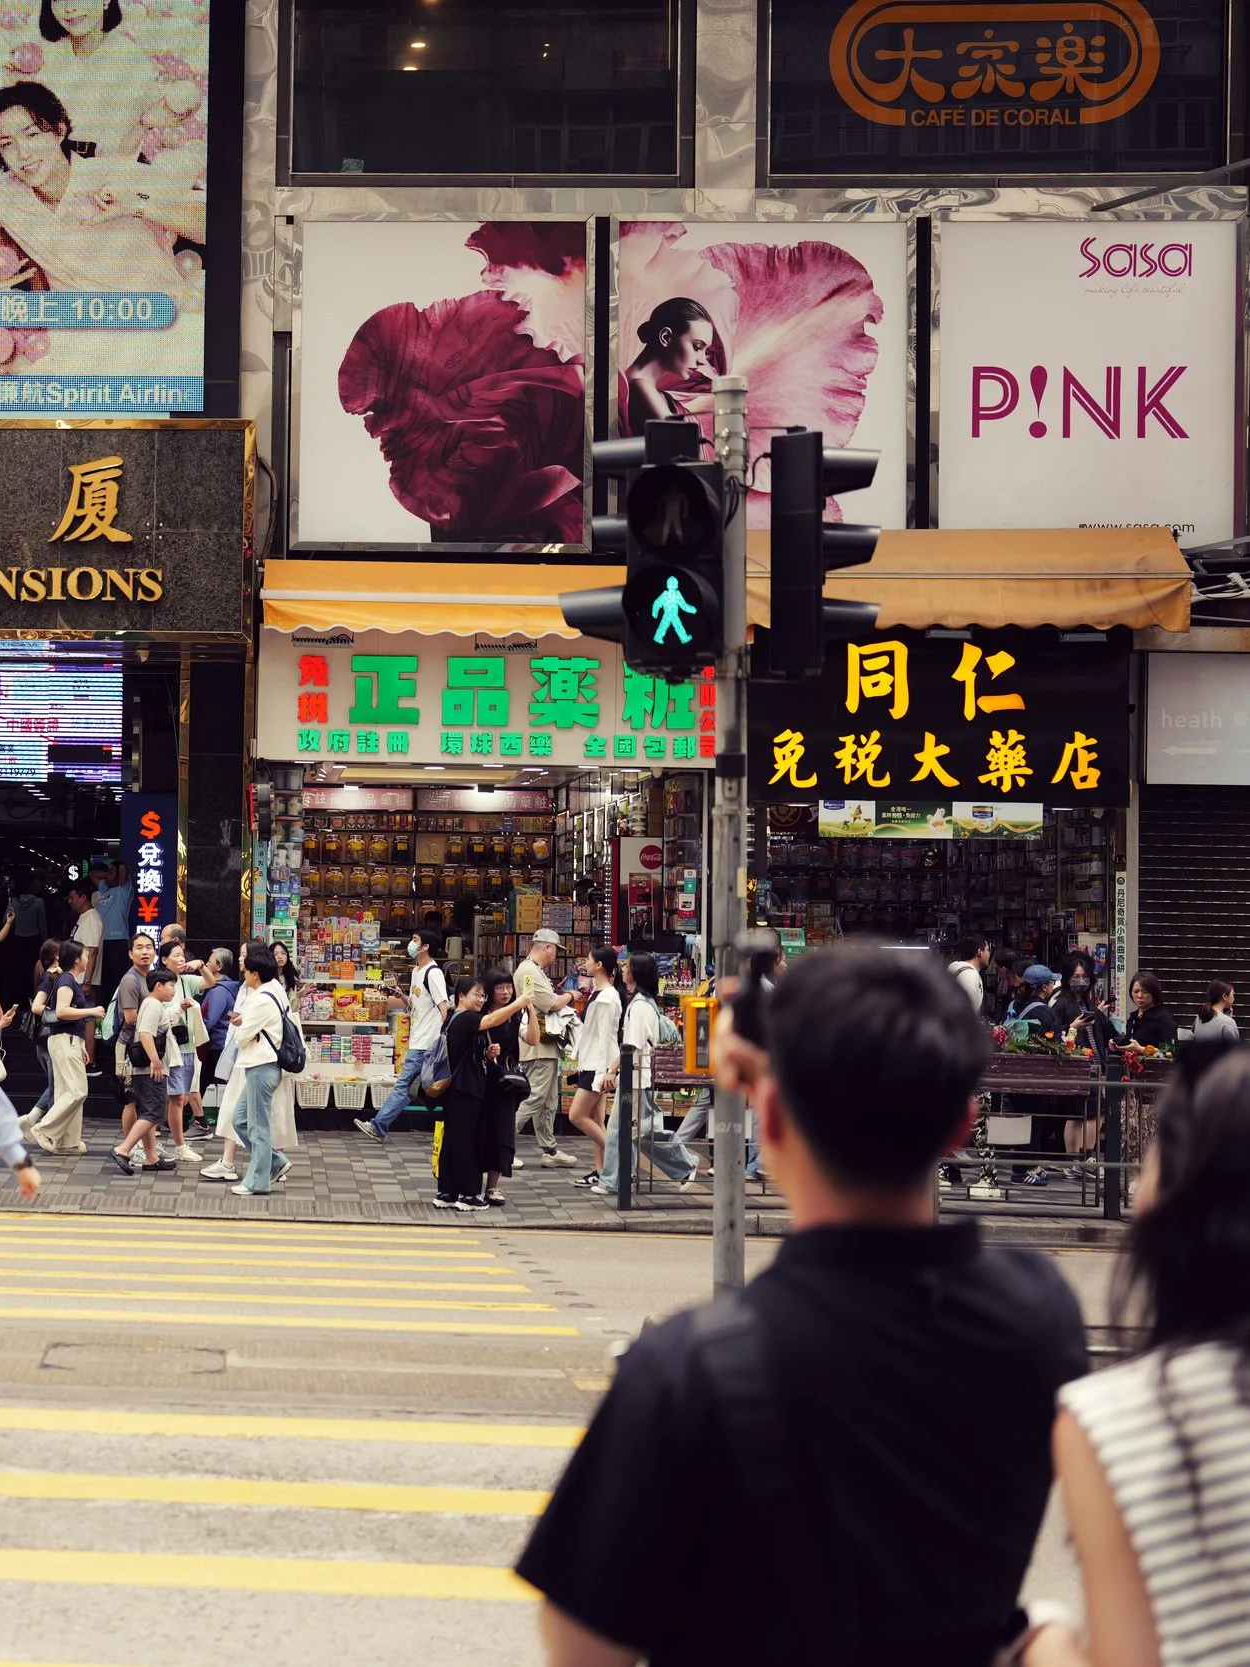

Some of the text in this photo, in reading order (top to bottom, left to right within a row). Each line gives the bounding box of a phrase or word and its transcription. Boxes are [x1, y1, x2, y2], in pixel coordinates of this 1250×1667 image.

[910, 105, 1076, 126] CAFÉ DE CORAL
[0, 297, 59, 324] 晚上
[71, 298, 152, 321] 10:00
[971, 365, 1190, 440] P!NK
[845, 640, 1026, 721] 同仁
[1161, 708, 1222, 728] heath
[297, 729, 410, 754] 政府註冊
[584, 733, 698, 760] 全國包郵
